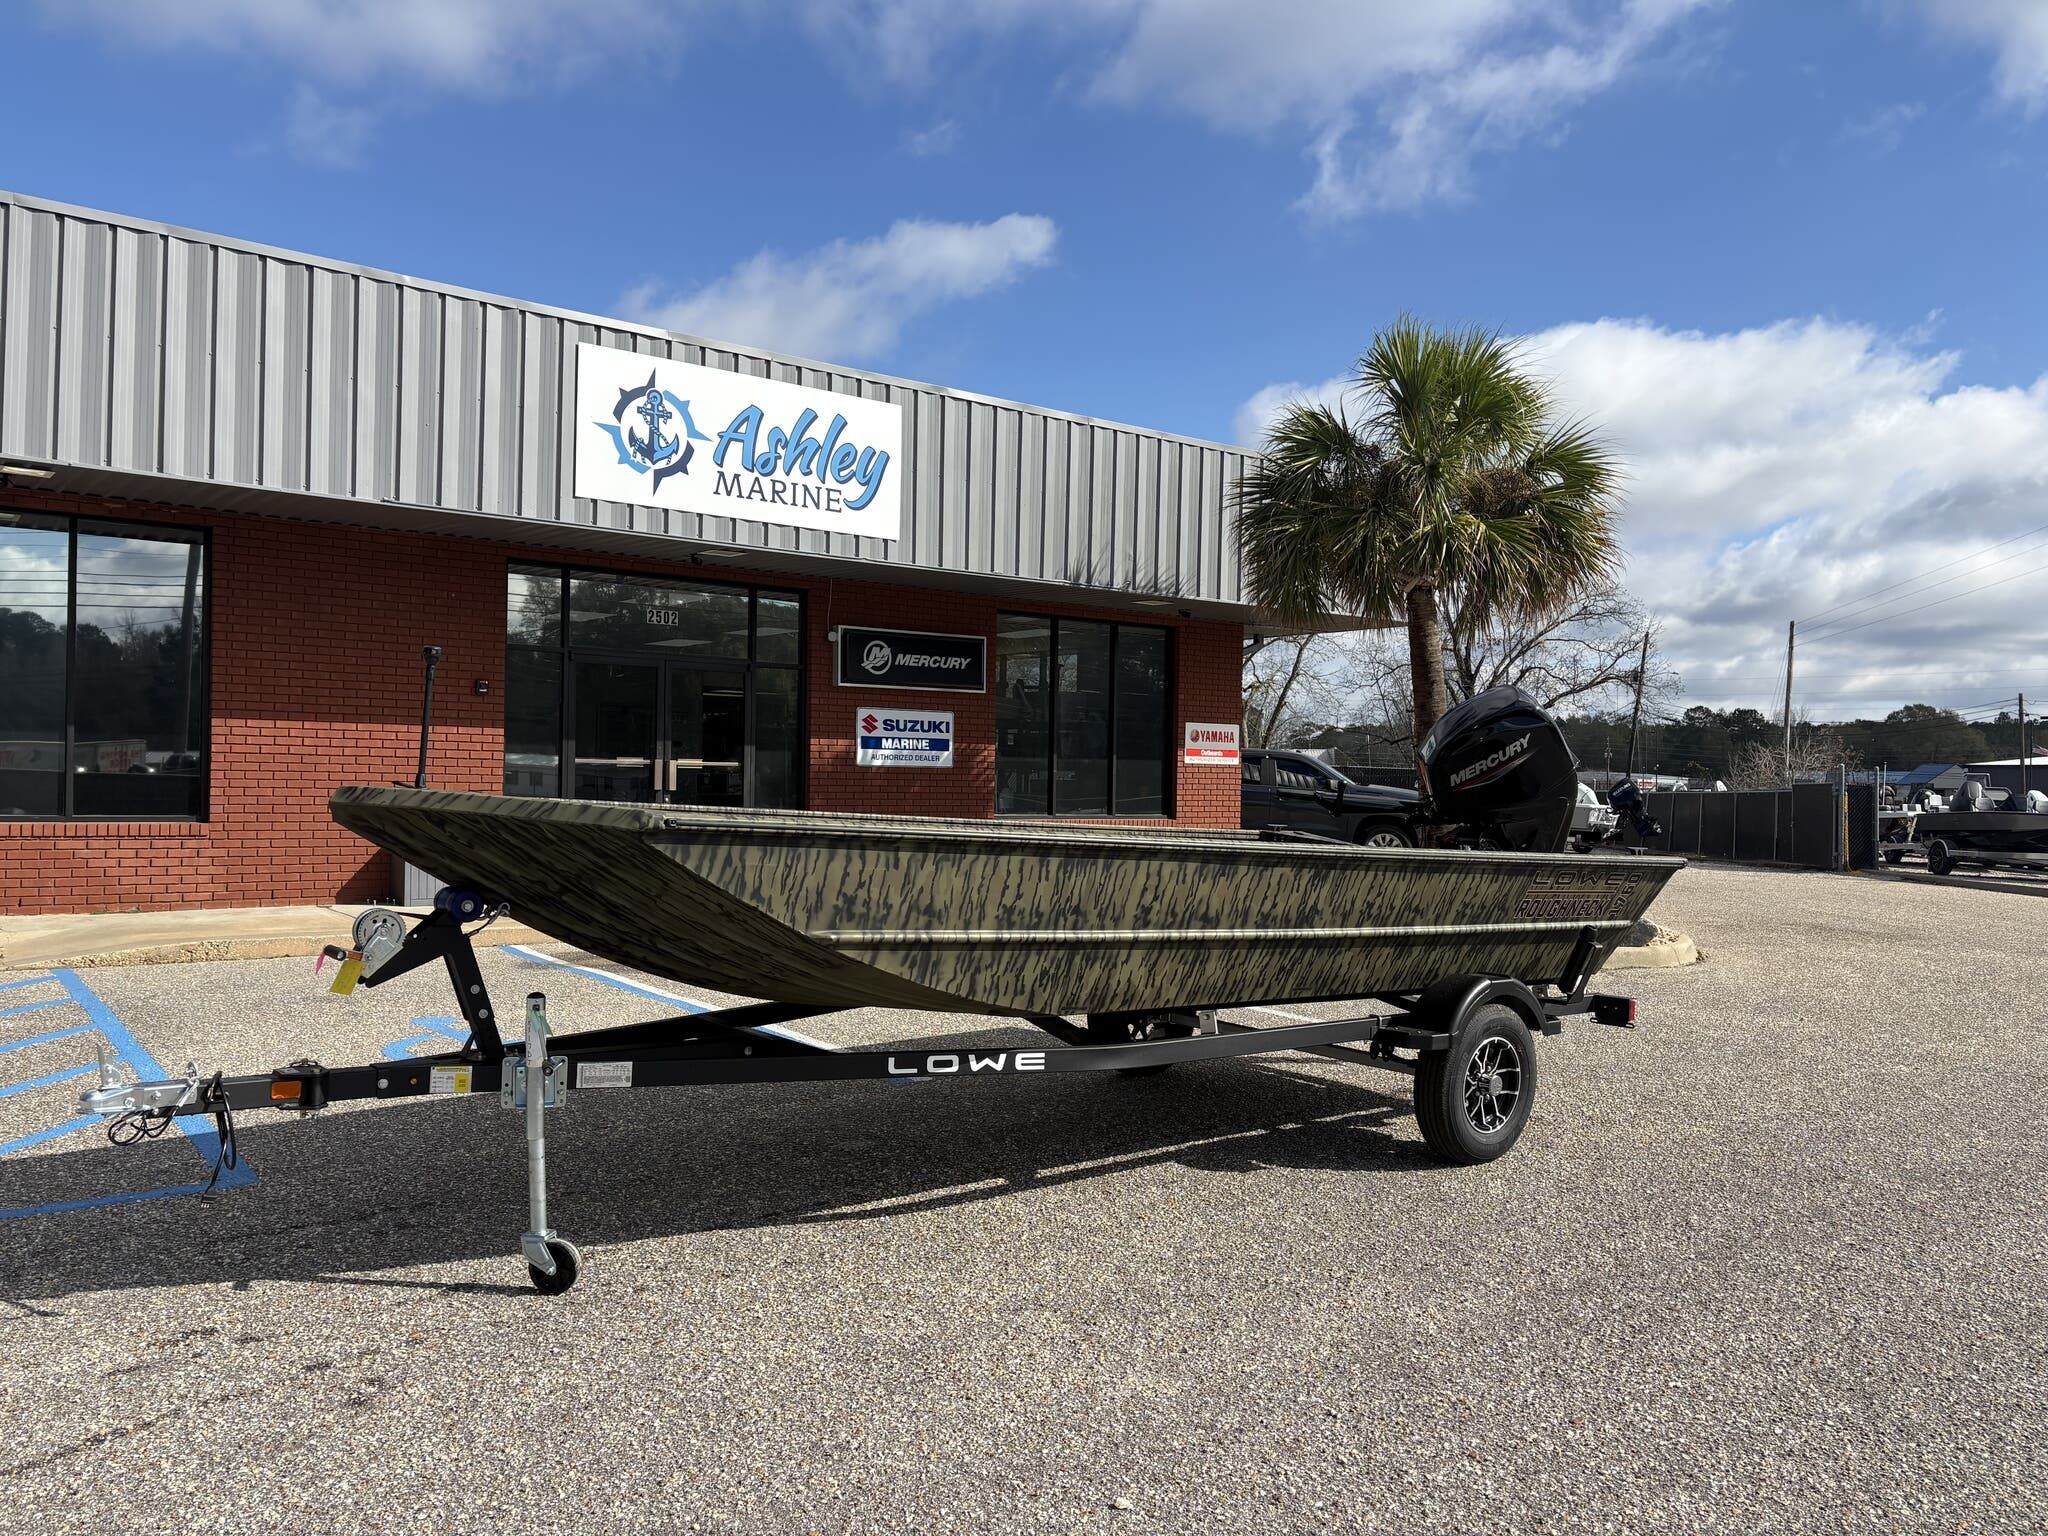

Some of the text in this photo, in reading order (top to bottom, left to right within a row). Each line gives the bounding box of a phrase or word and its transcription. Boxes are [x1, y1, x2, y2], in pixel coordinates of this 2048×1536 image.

[712, 404, 890, 510] Ashley
[713, 470, 843, 513] MARINE
[647, 609, 678, 625] 2502
[895, 653, 972, 669] MERCURY
[882, 718, 950, 734] SUZUKI
[881, 737, 930, 750] MARINE
[1200, 730, 1235, 744] YAMAHA
[870, 753, 940, 762] AUTHORIZED DEALER
[1450, 732, 1532, 787] MERCURY
[1532, 870, 1626, 887] LOWE
[1514, 898, 1612, 919] ROUGHNECK
[887, 1052, 1046, 1075] LOWE
